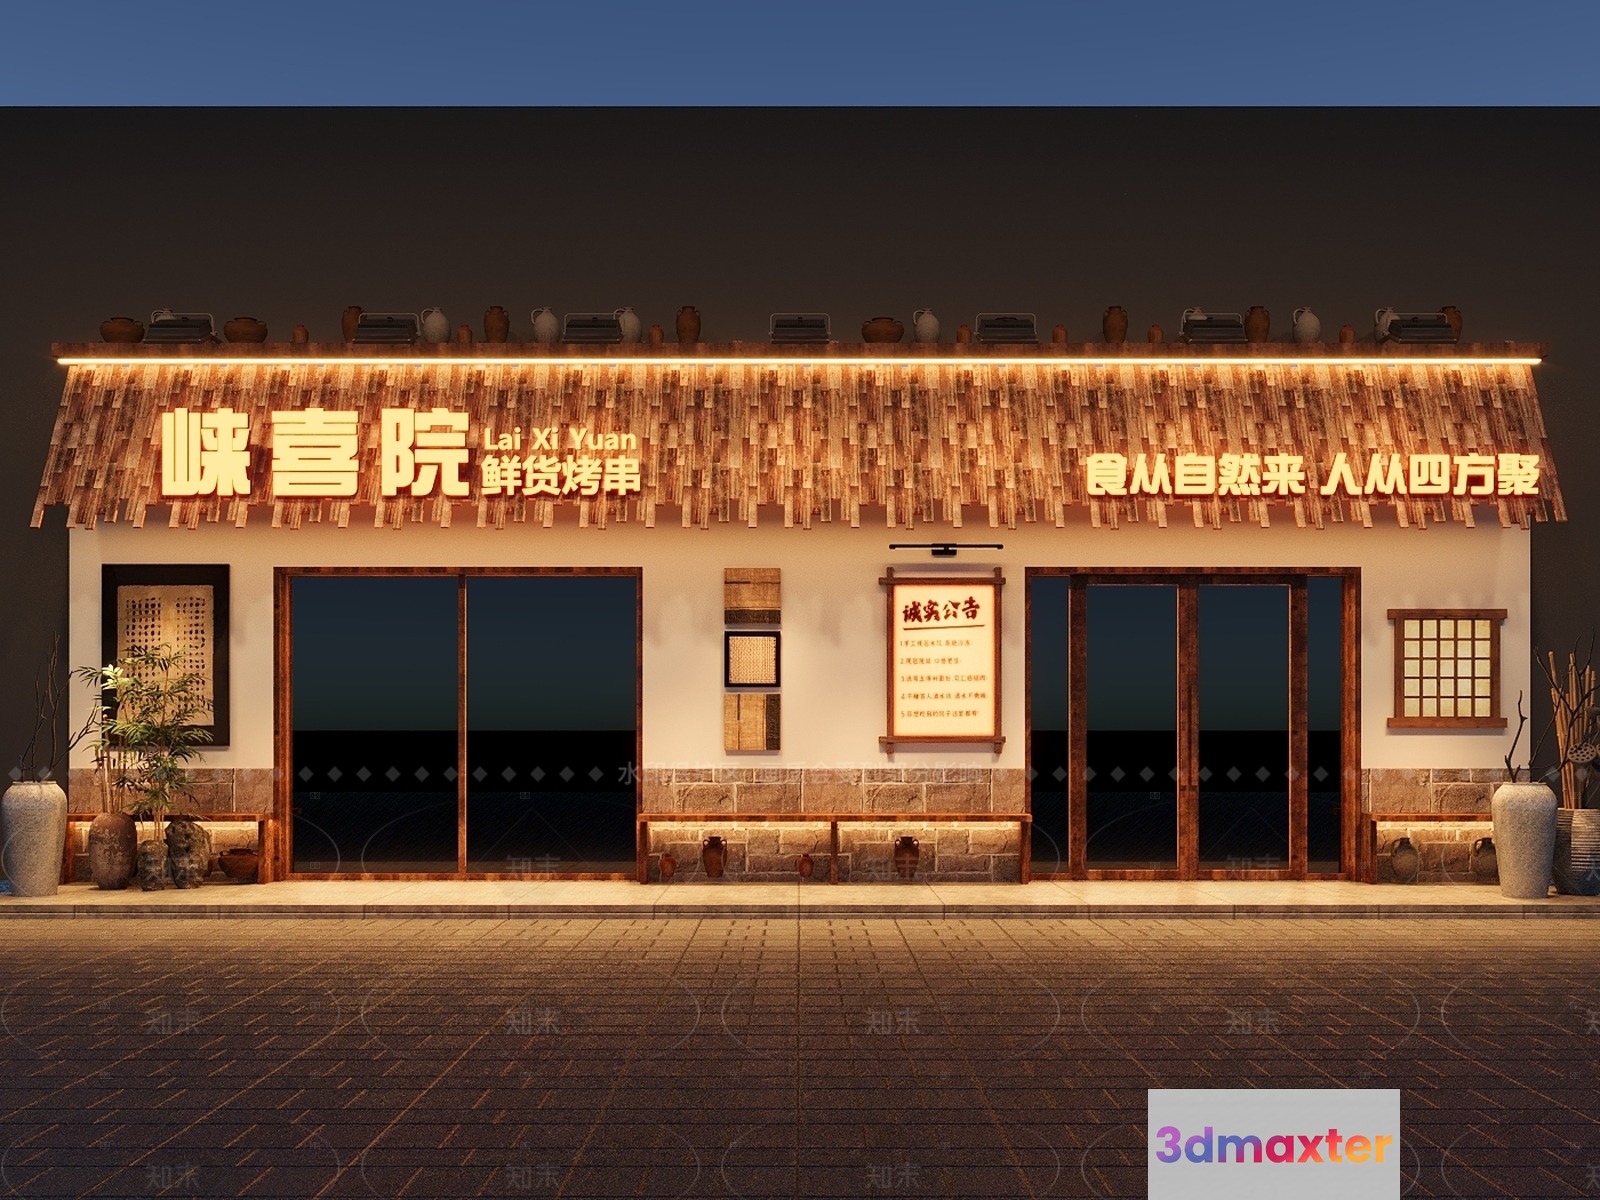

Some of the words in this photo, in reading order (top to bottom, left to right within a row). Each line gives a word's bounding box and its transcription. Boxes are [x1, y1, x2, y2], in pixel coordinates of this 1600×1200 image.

[161, 407, 469, 497] 崃喜院
[484, 427, 521, 450] Lai
[531, 427, 559, 450] Xi
[569, 427, 637, 450] Yuan
[481, 455, 641, 496] 鲜货烤串
[1086, 452, 1306, 495] 食从自然来
[1320, 452, 1540, 495] 人从四方聚
